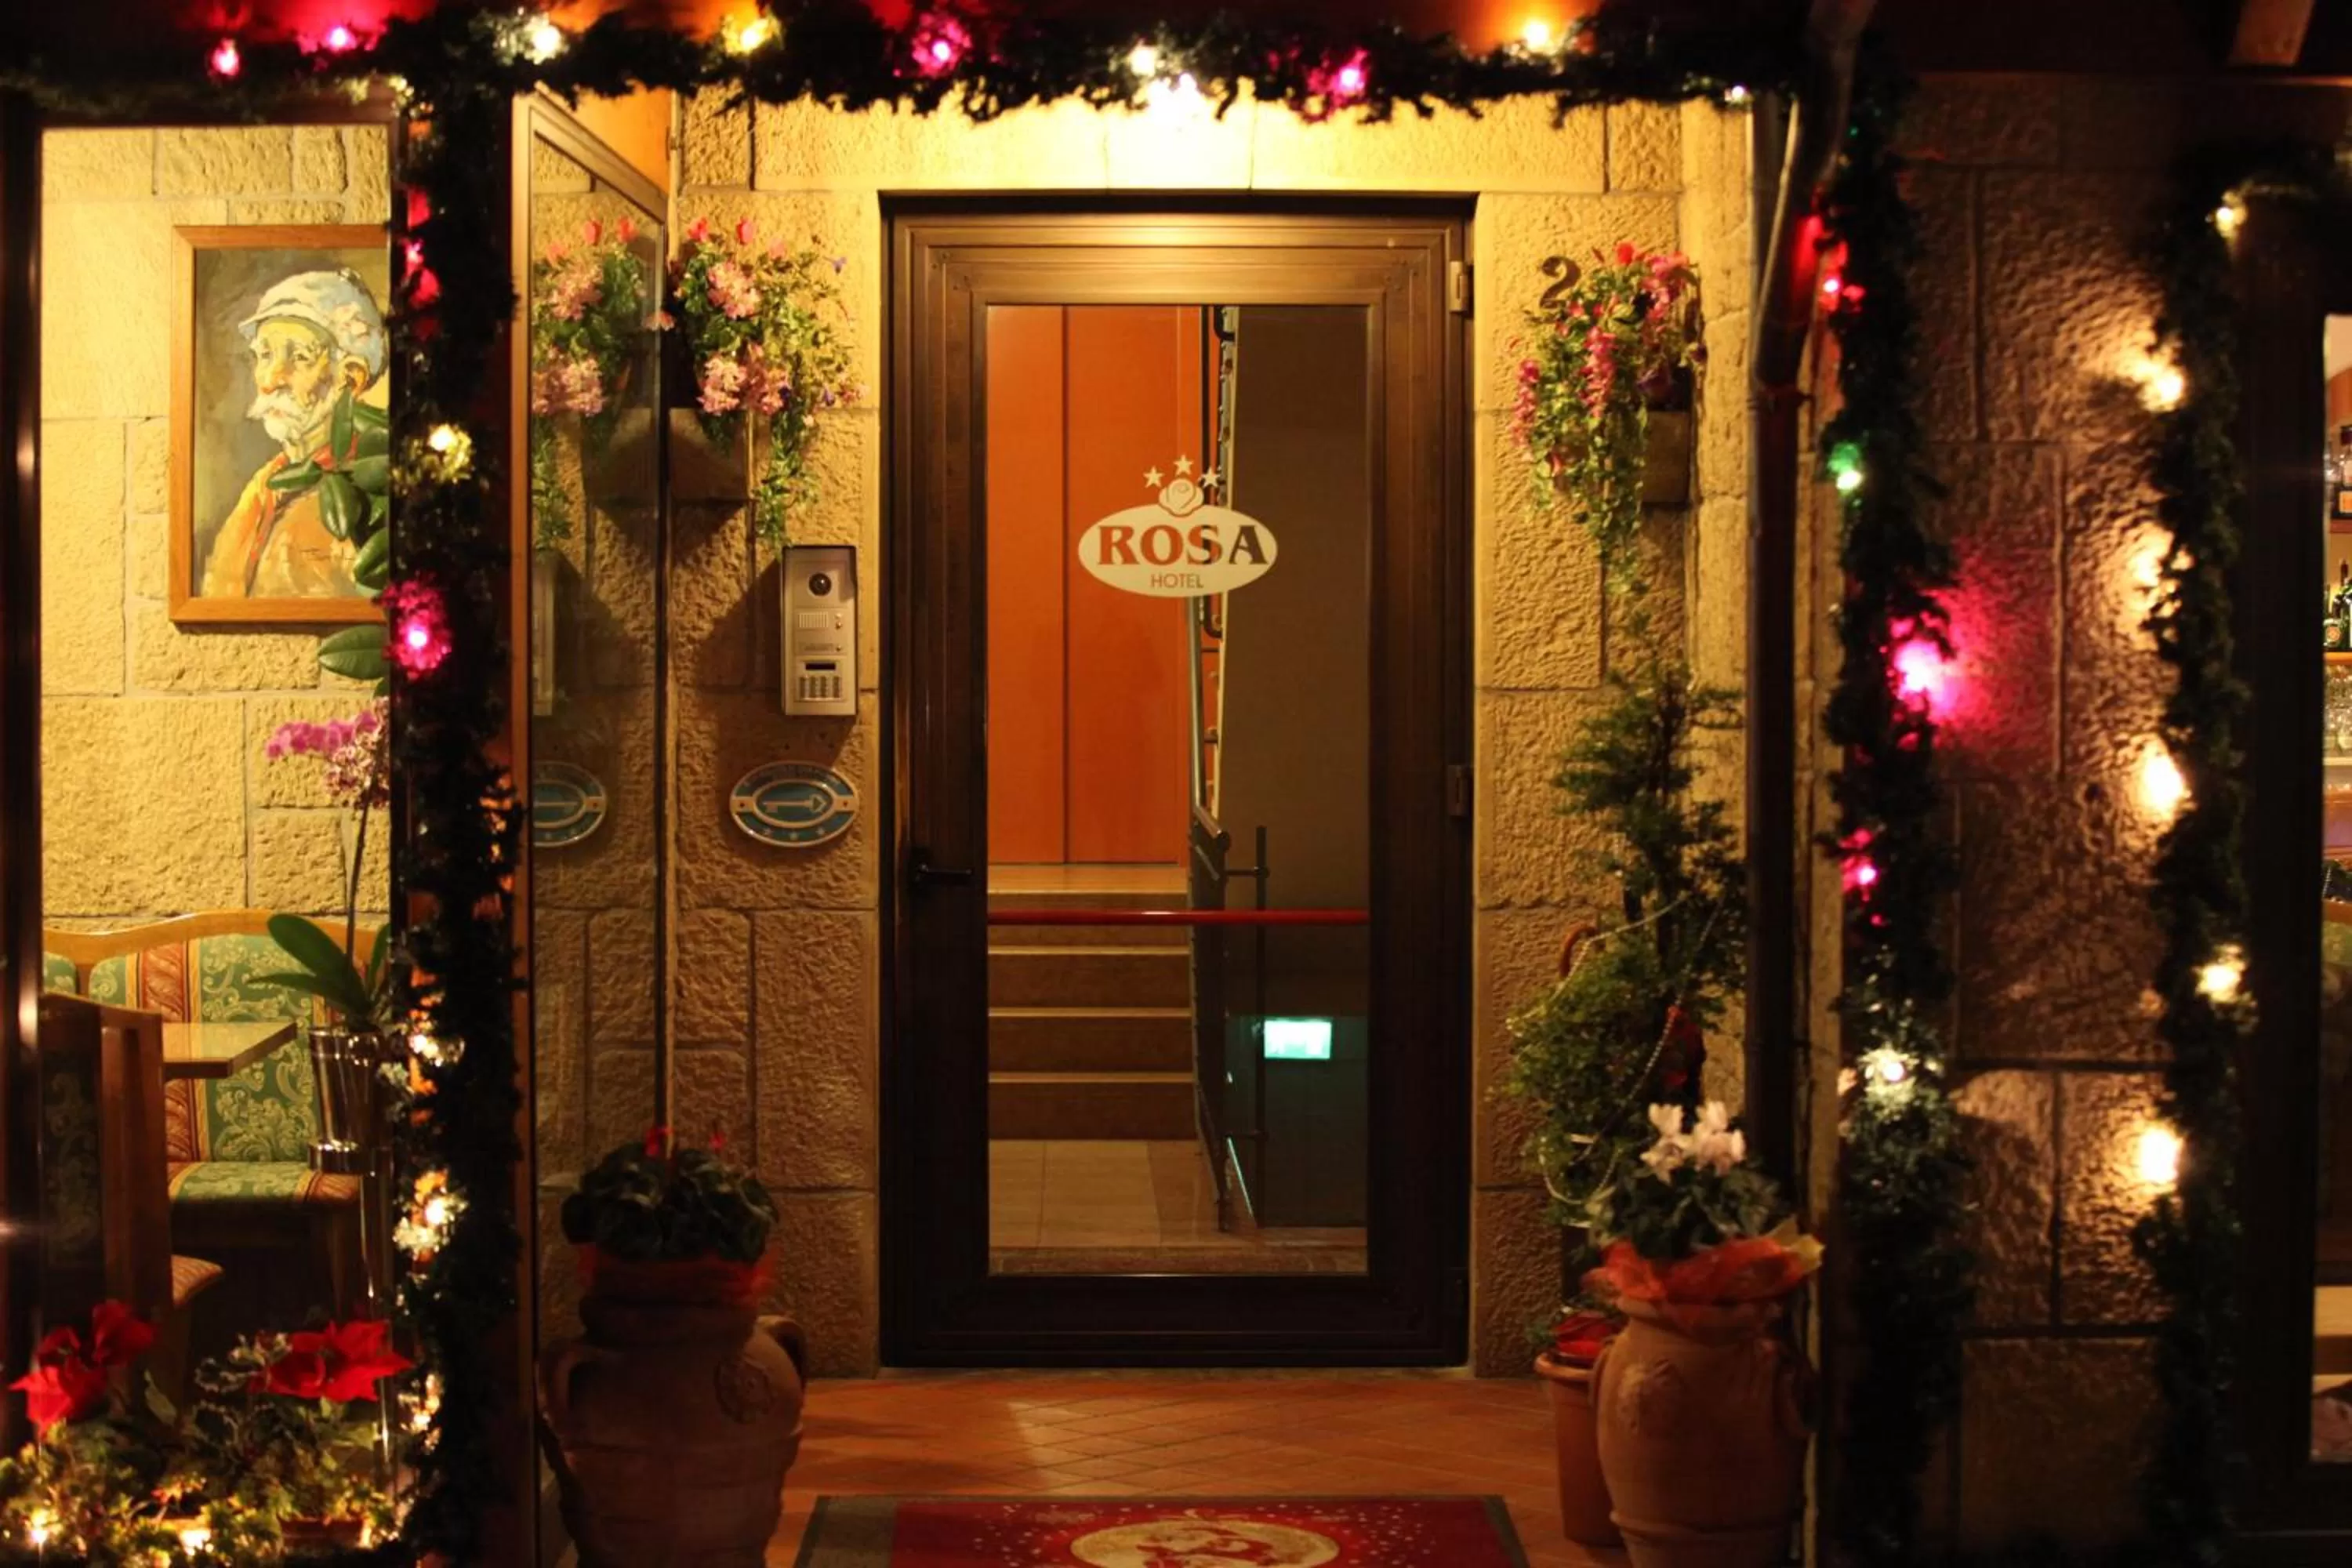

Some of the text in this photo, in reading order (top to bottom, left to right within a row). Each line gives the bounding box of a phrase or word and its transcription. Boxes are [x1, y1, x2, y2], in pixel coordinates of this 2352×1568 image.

[1539, 255, 1581, 310] 2
[1098, 524, 1268, 566] ROSA
[1150, 573, 1204, 589] HOTEL
